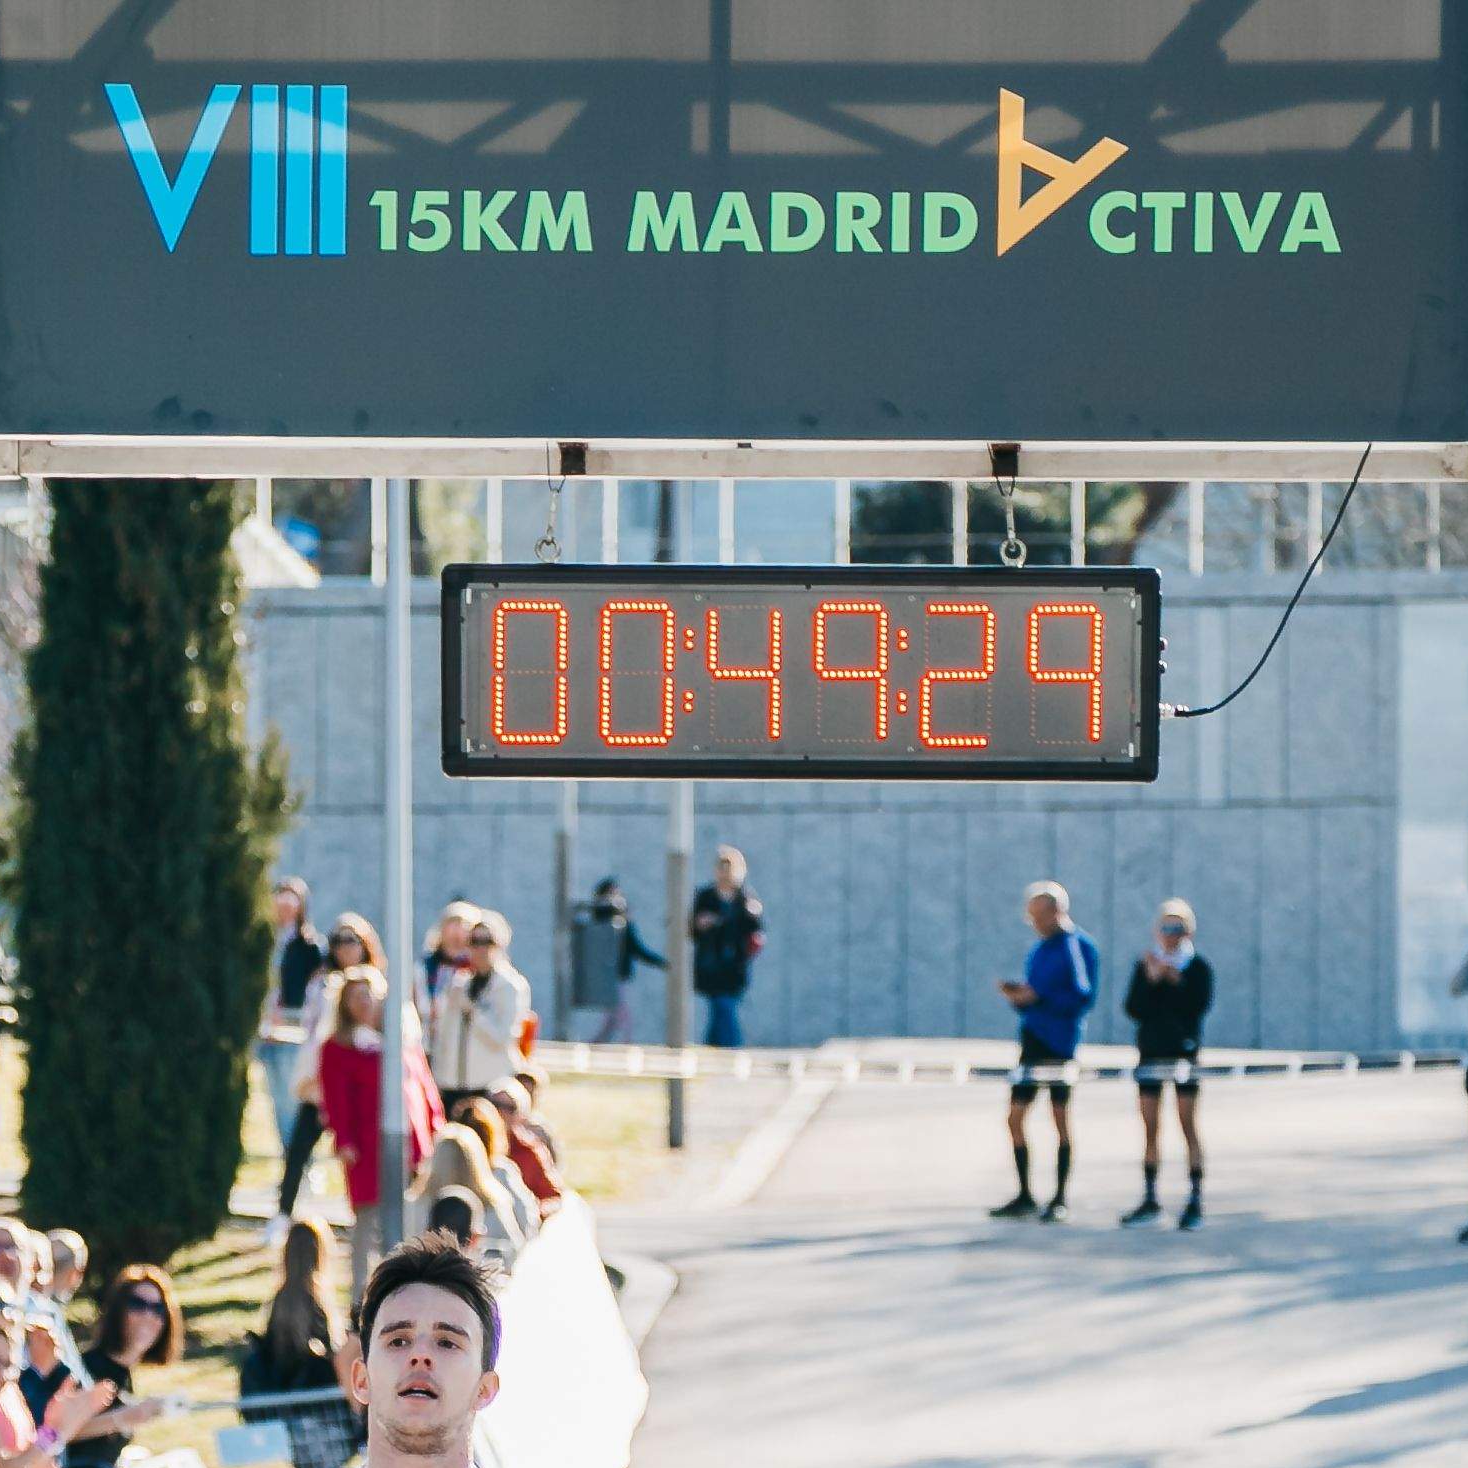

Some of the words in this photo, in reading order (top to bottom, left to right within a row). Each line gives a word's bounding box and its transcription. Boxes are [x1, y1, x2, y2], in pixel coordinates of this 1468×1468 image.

[104, 84, 349, 256] VIII
[369, 190, 593, 253] 15KM
[627, 191, 979, 254] MADRID
[491, 599, 1104, 749] 00:49:29
